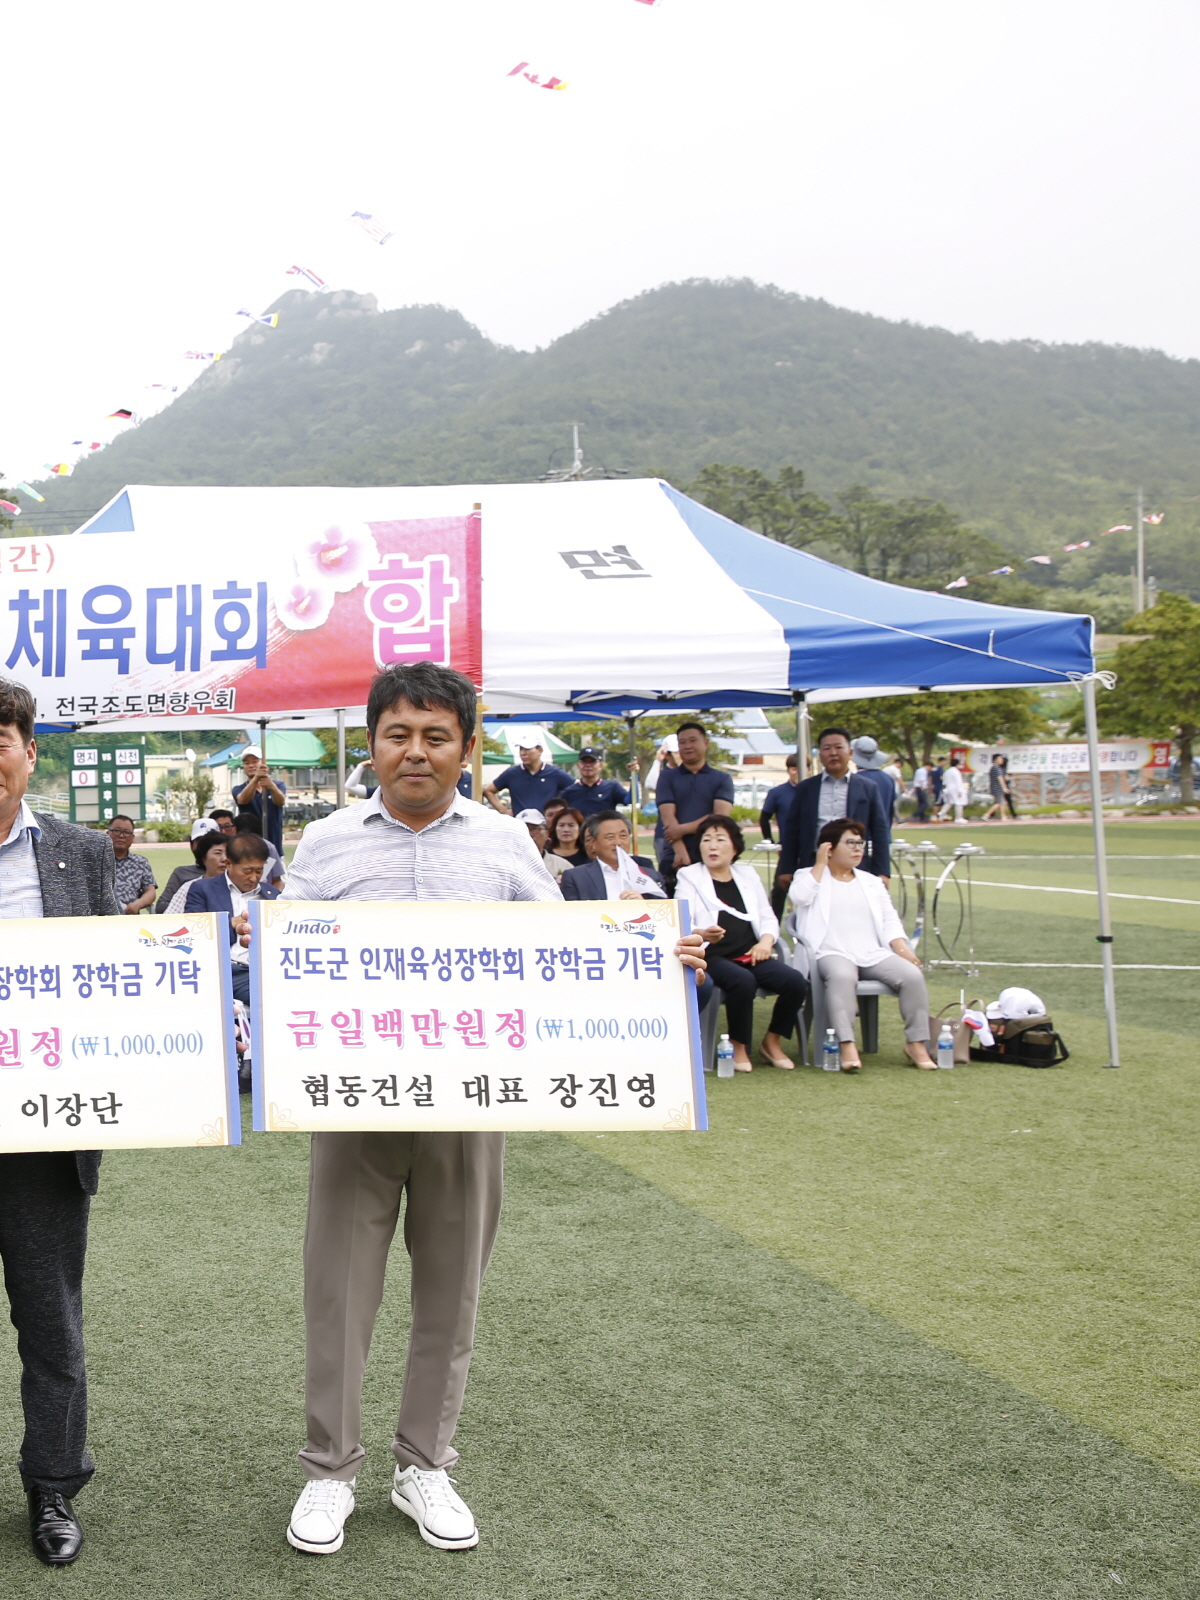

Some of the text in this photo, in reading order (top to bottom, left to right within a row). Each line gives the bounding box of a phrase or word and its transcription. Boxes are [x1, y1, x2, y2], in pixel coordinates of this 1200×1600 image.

[558, 544, 653, 579] 면
[5, 581, 267, 677] 체육대회
[366, 557, 456, 666] 합
[55, 690, 236, 717] 전국조도면향우회
[118, 752, 140, 763] 신전
[282, 921, 331, 934] Jindo
[73, 963, 143, 998] 장학금
[155, 960, 201, 994] 기탁
[280, 947, 664, 982] 진도군 인재육성장학회 장학금 기탁
[287, 1009, 524, 1048] 금일백만원정
[301, 1073, 655, 1108] 협동건설 대표 장진영
[21, 1092, 123, 1128] 이장단
